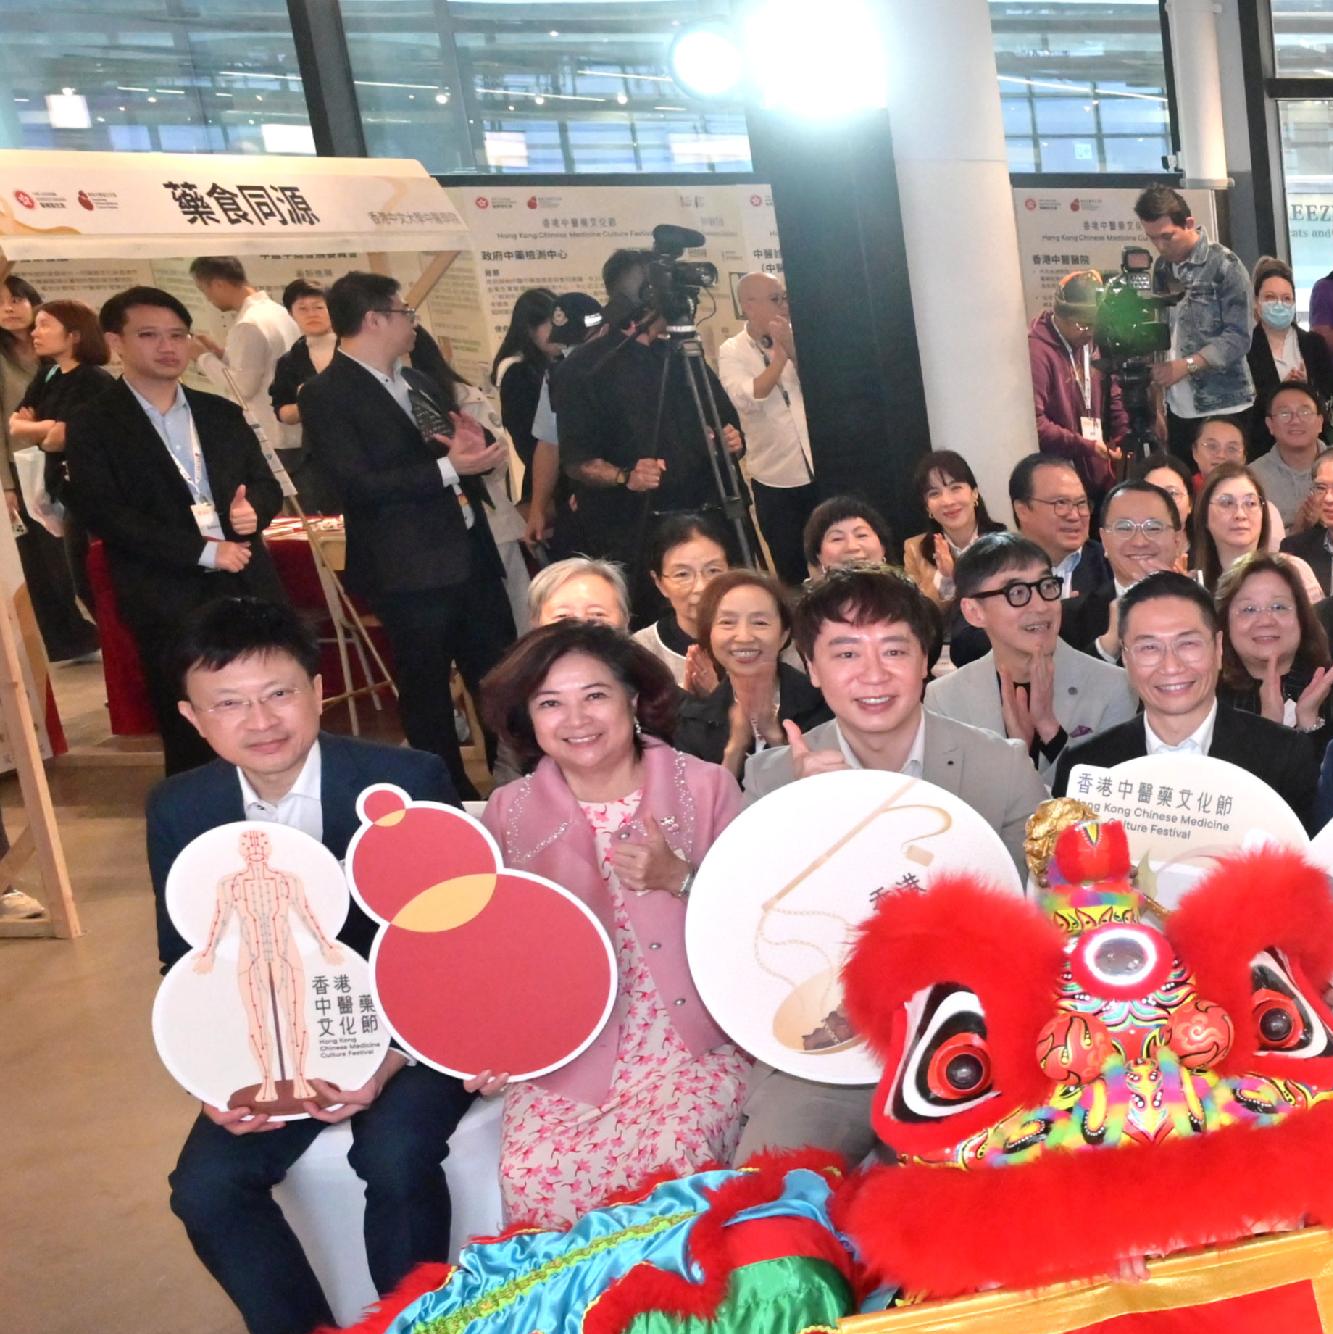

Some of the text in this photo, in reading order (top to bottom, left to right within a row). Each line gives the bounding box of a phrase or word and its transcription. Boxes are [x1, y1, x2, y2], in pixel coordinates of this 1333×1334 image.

[162, 180, 320, 226] 藥食同源
[1077, 772, 1234, 817] 香港中醫藥文化節
[1104, 802, 1131, 818] Kong
[1134, 808, 1179, 825] Chinese
[1180, 815, 1230, 832] Medicine
[1150, 823, 1191, 840] Festival
[311, 974, 352, 995] 香港
[314, 993, 377, 1016] 中醫藥
[317, 1014, 379, 1037] 文化節
